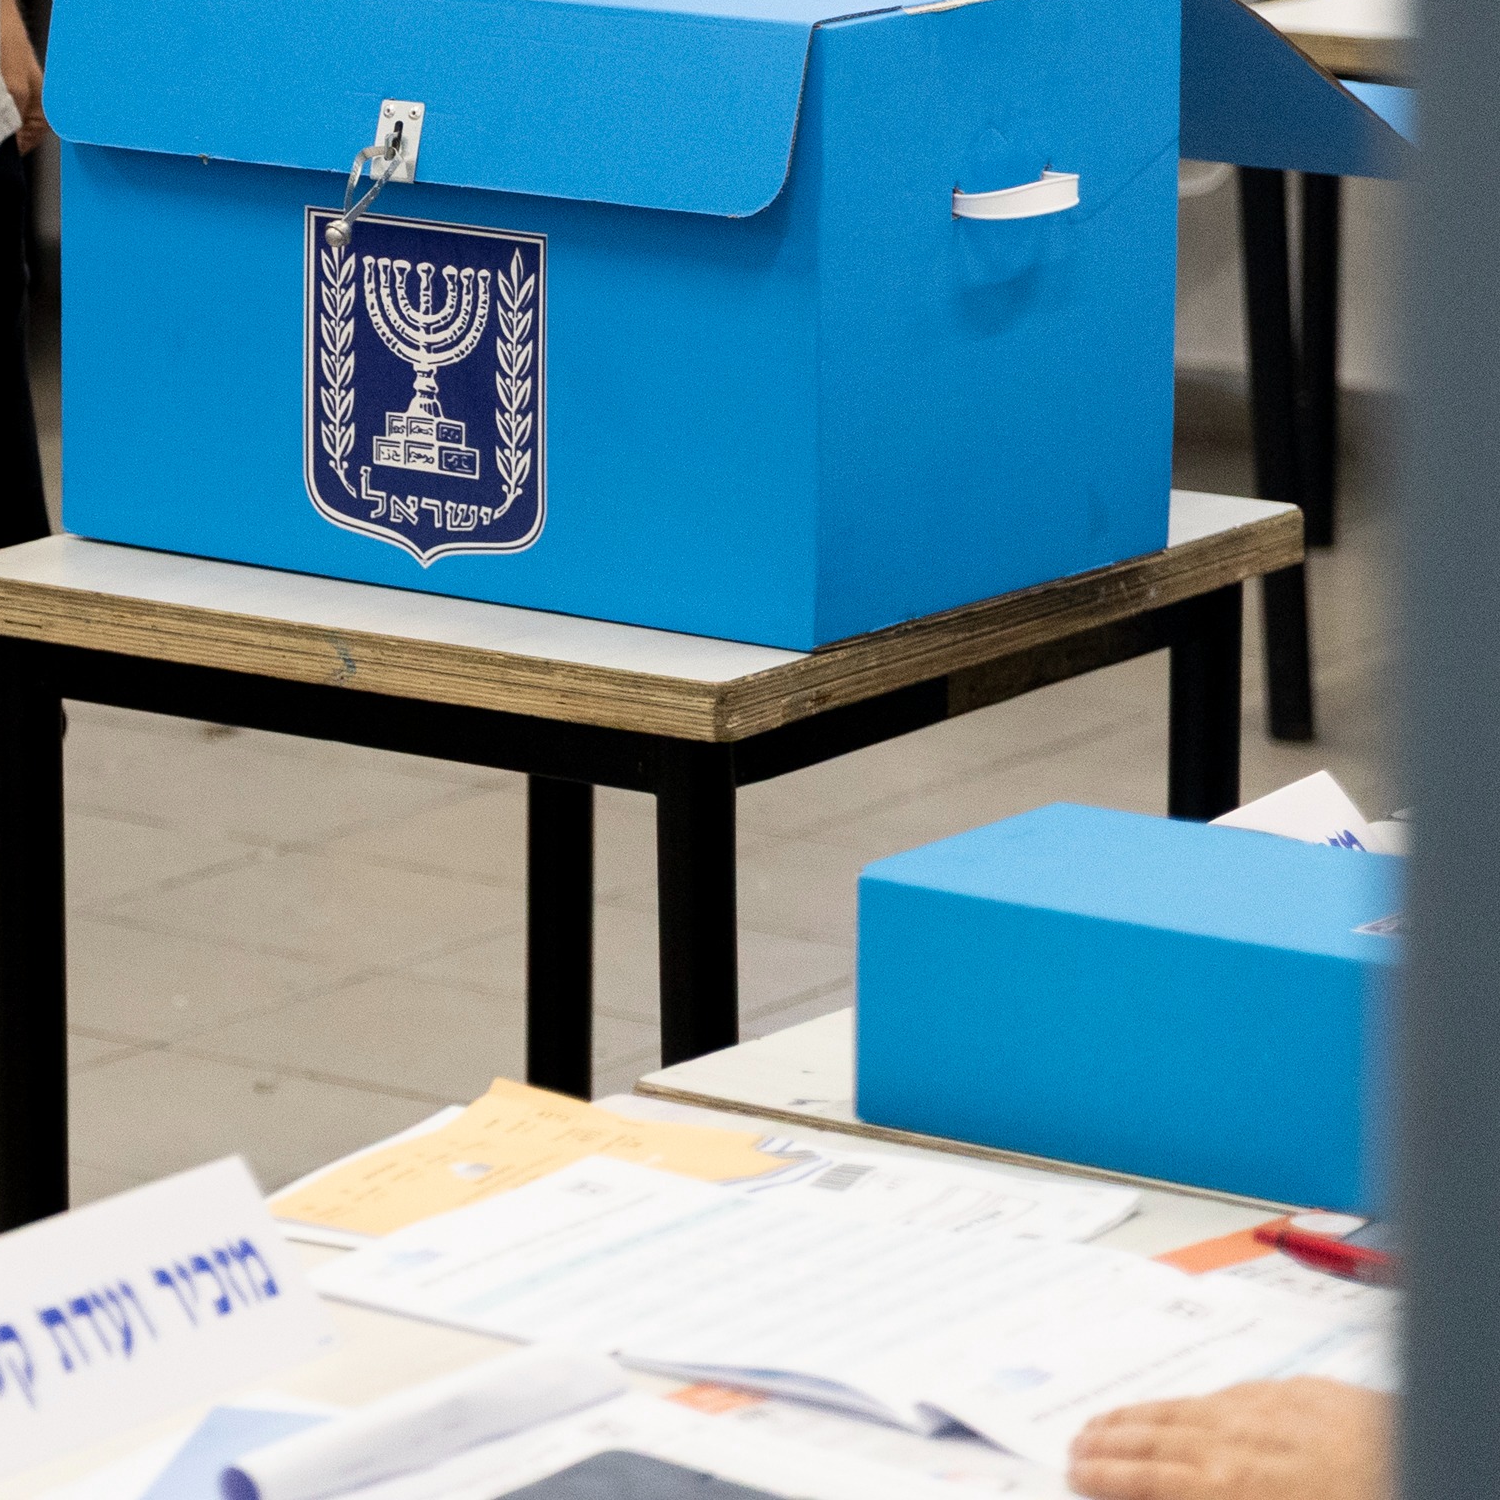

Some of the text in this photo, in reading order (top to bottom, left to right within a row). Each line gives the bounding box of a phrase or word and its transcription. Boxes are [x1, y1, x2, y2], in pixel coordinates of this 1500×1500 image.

[360, 465, 492, 531] ישראל
[39, 1279, 159, 1372] ועדת
[153, 1238, 279, 1326] מזכיר
